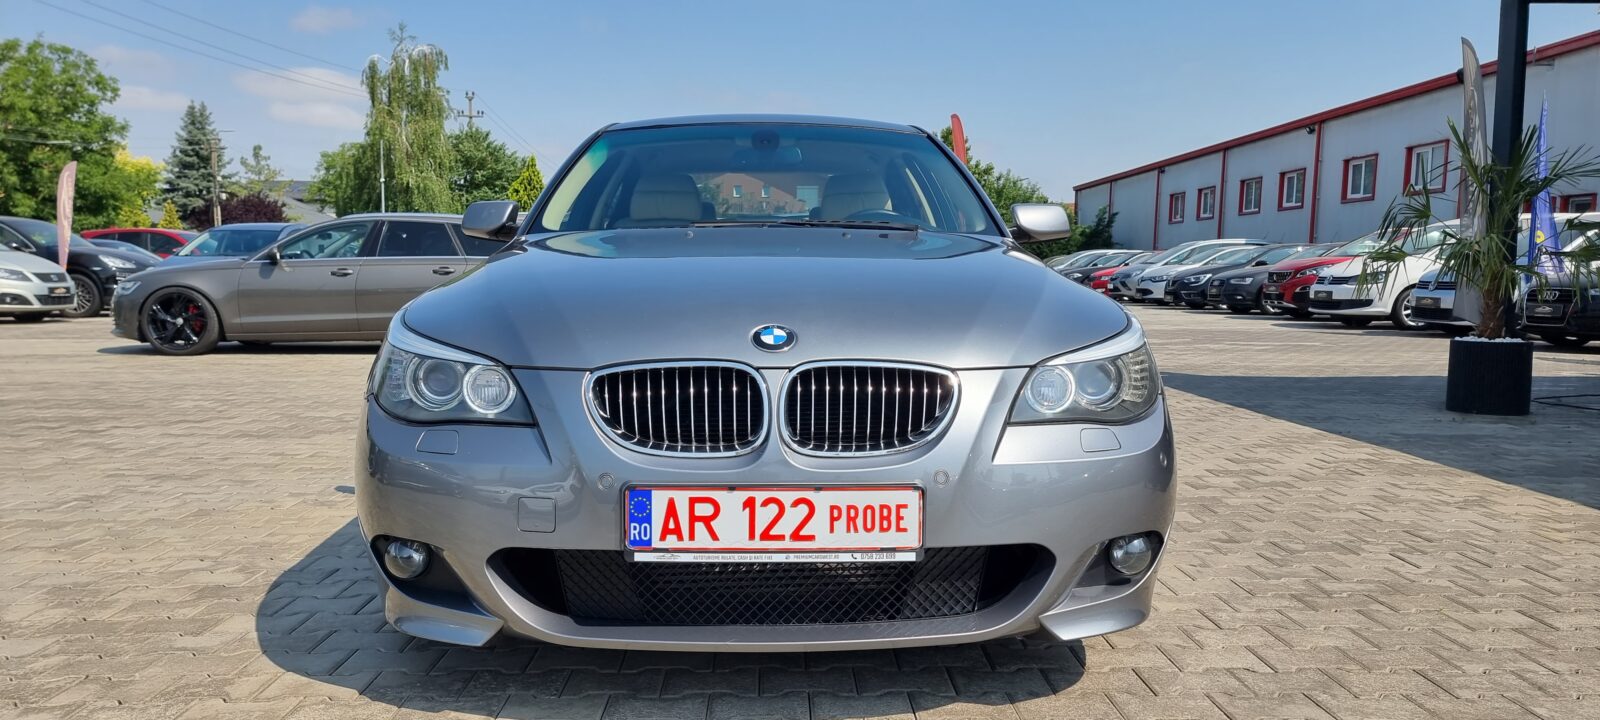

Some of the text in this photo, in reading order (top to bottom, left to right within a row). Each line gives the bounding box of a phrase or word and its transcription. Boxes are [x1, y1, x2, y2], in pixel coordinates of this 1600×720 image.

[630, 523, 650, 540] RO
[659, 496, 908, 542] AR 122 PROBE
